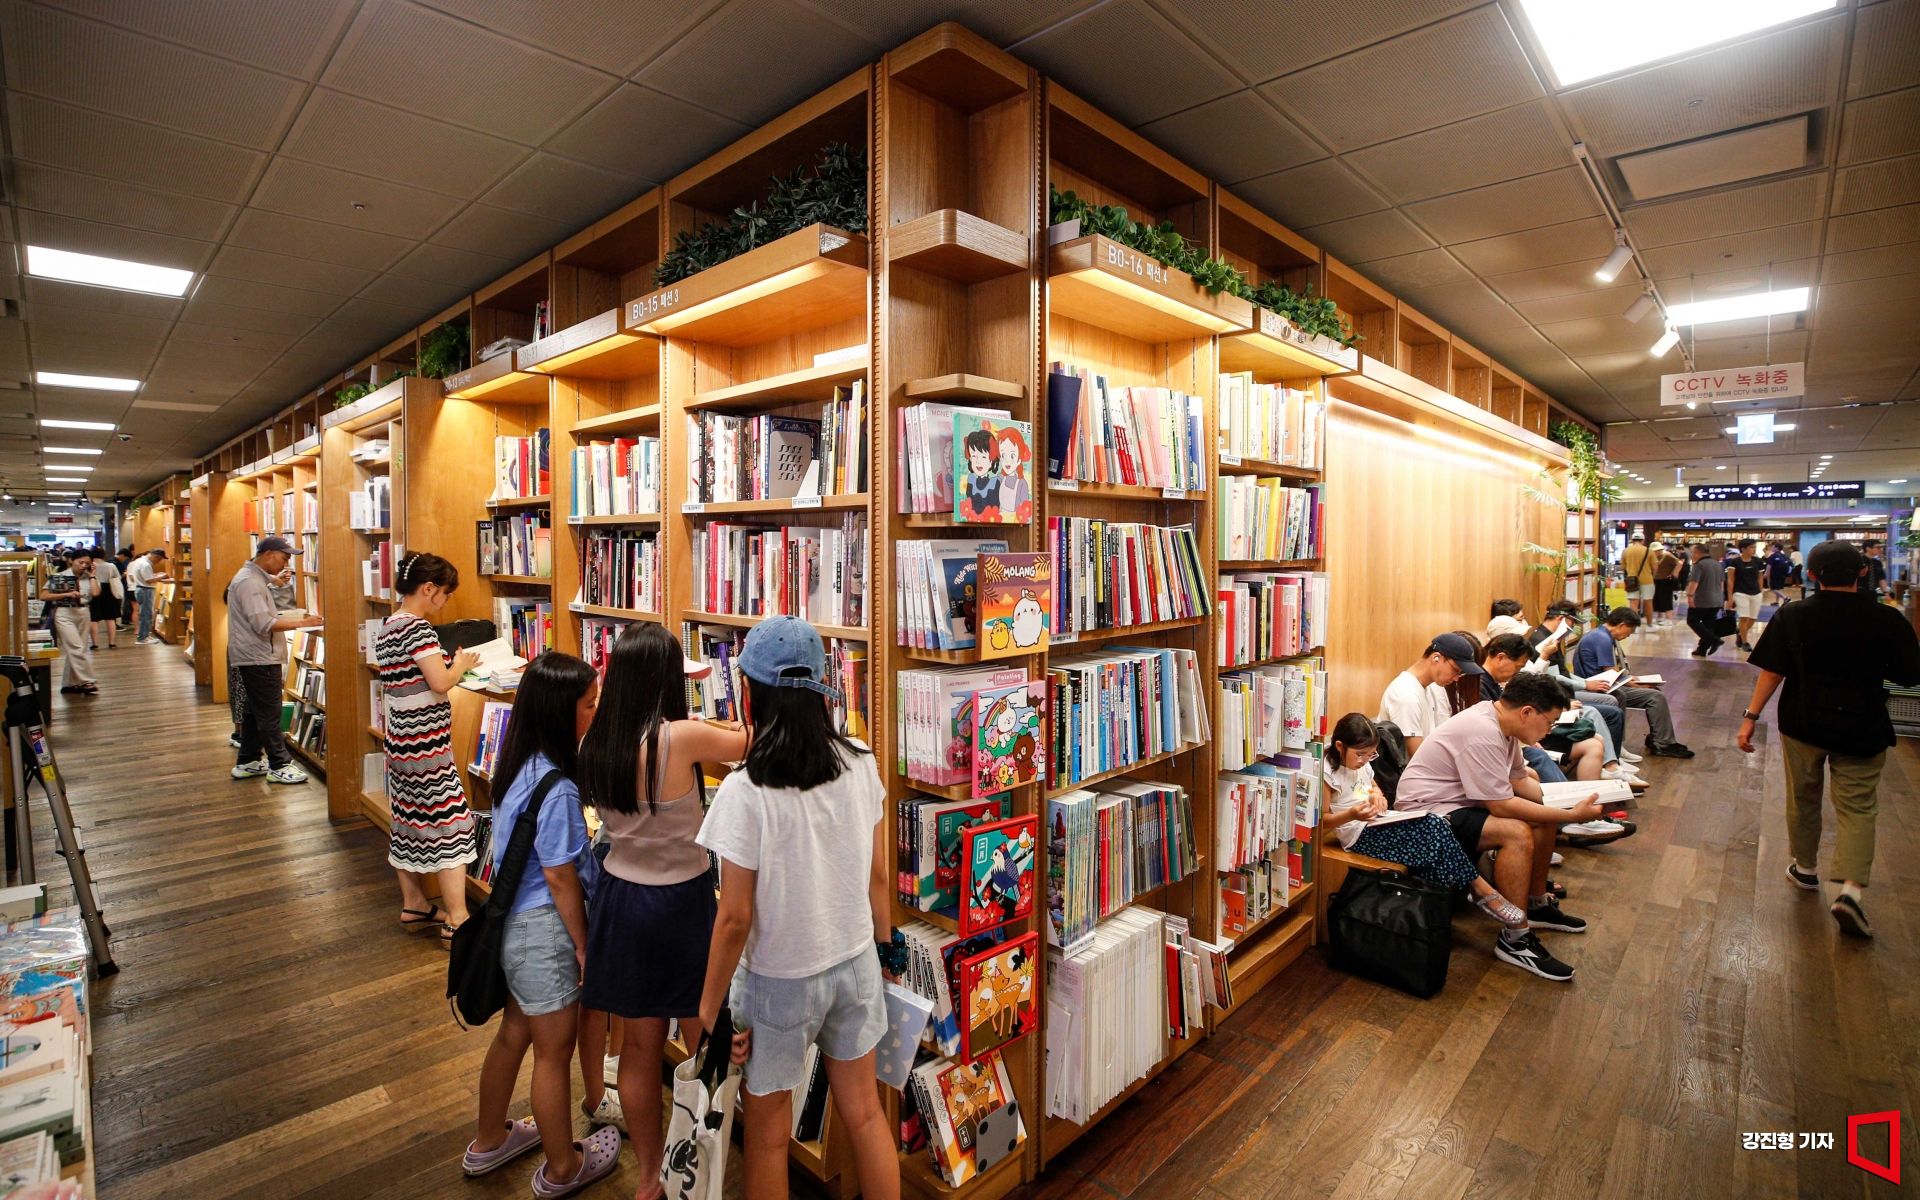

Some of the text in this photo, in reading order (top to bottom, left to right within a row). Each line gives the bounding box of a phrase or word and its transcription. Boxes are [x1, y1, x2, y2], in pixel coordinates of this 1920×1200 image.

[1163, 270, 1168, 285] 4
[674, 288, 679, 303] 3
[1674, 369, 1789, 392] CCTV 녹화중
[1003, 565, 1037, 578] MOLANG
